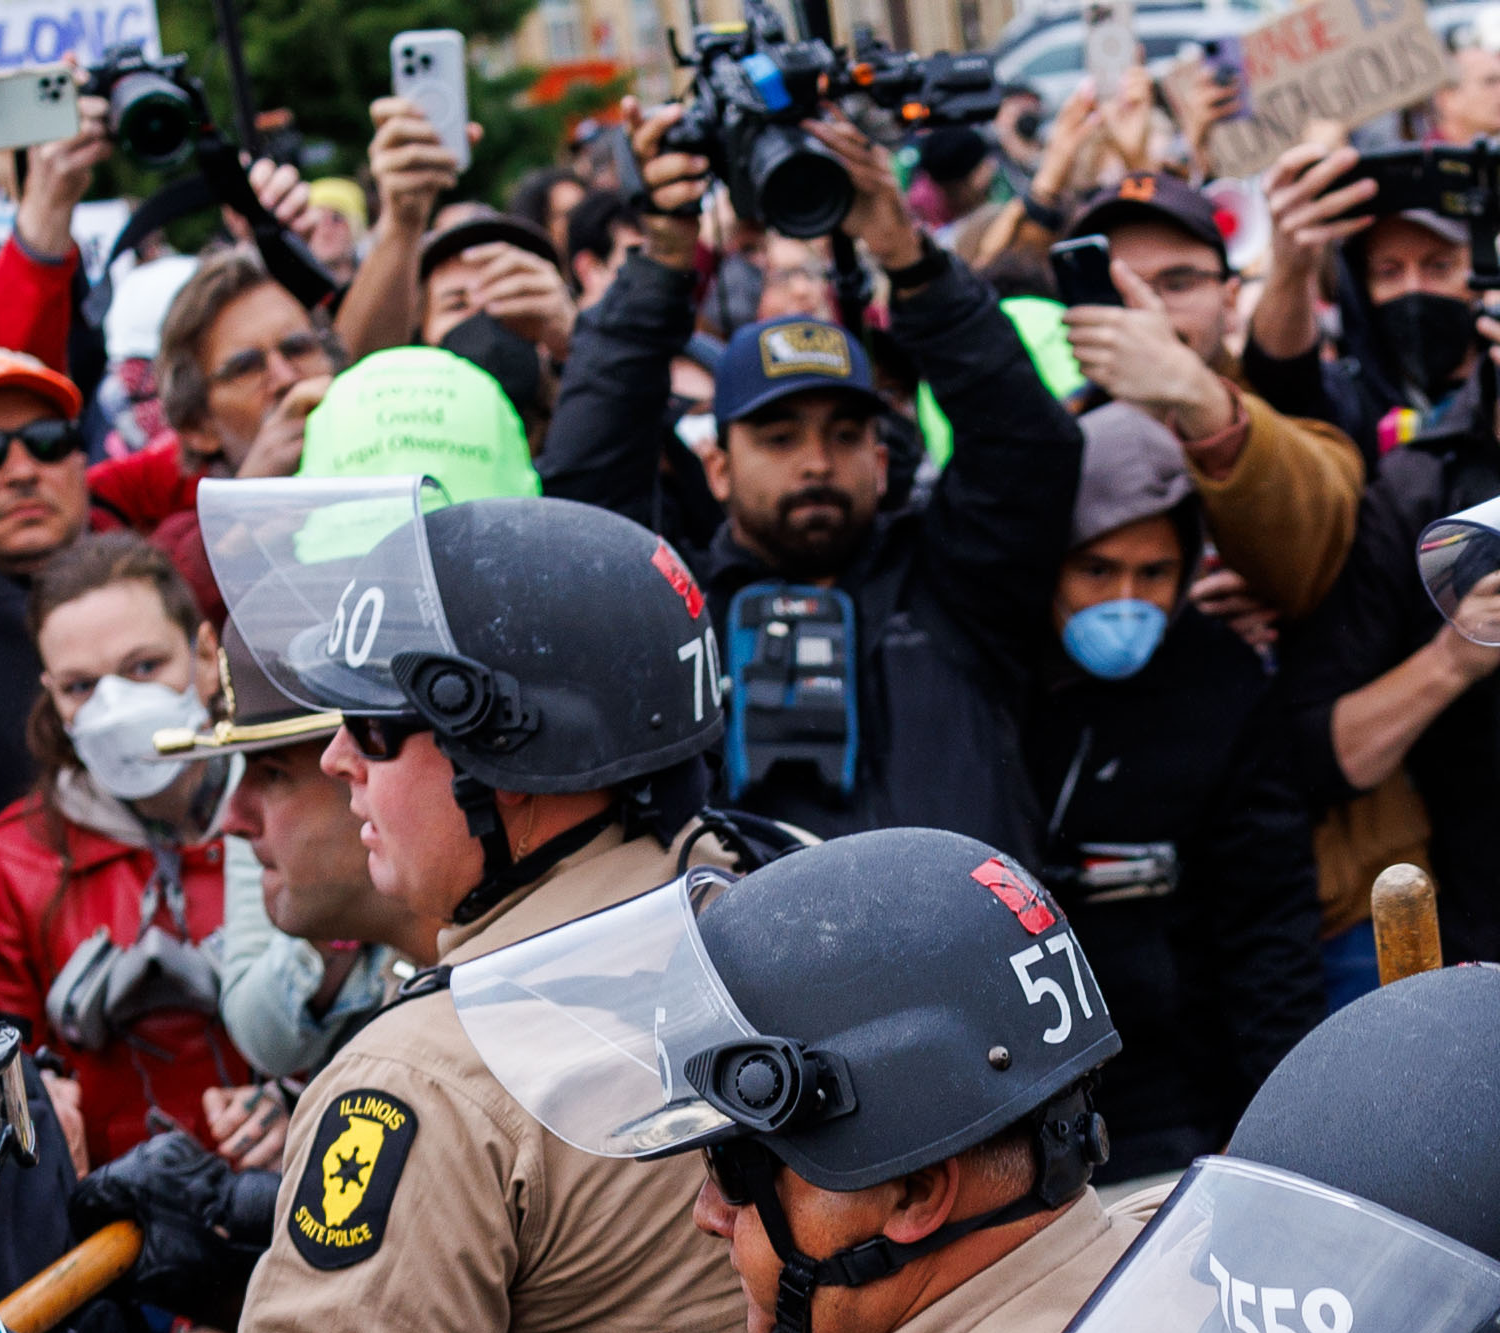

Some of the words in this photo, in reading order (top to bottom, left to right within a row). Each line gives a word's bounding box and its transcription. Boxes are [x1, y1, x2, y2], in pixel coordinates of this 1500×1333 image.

[1010, 932, 1108, 1043] 57
[339, 1097, 406, 1132] ILLINOIS
[295, 1206, 326, 1242] STATE
[325, 1223, 372, 1248] POLICE
